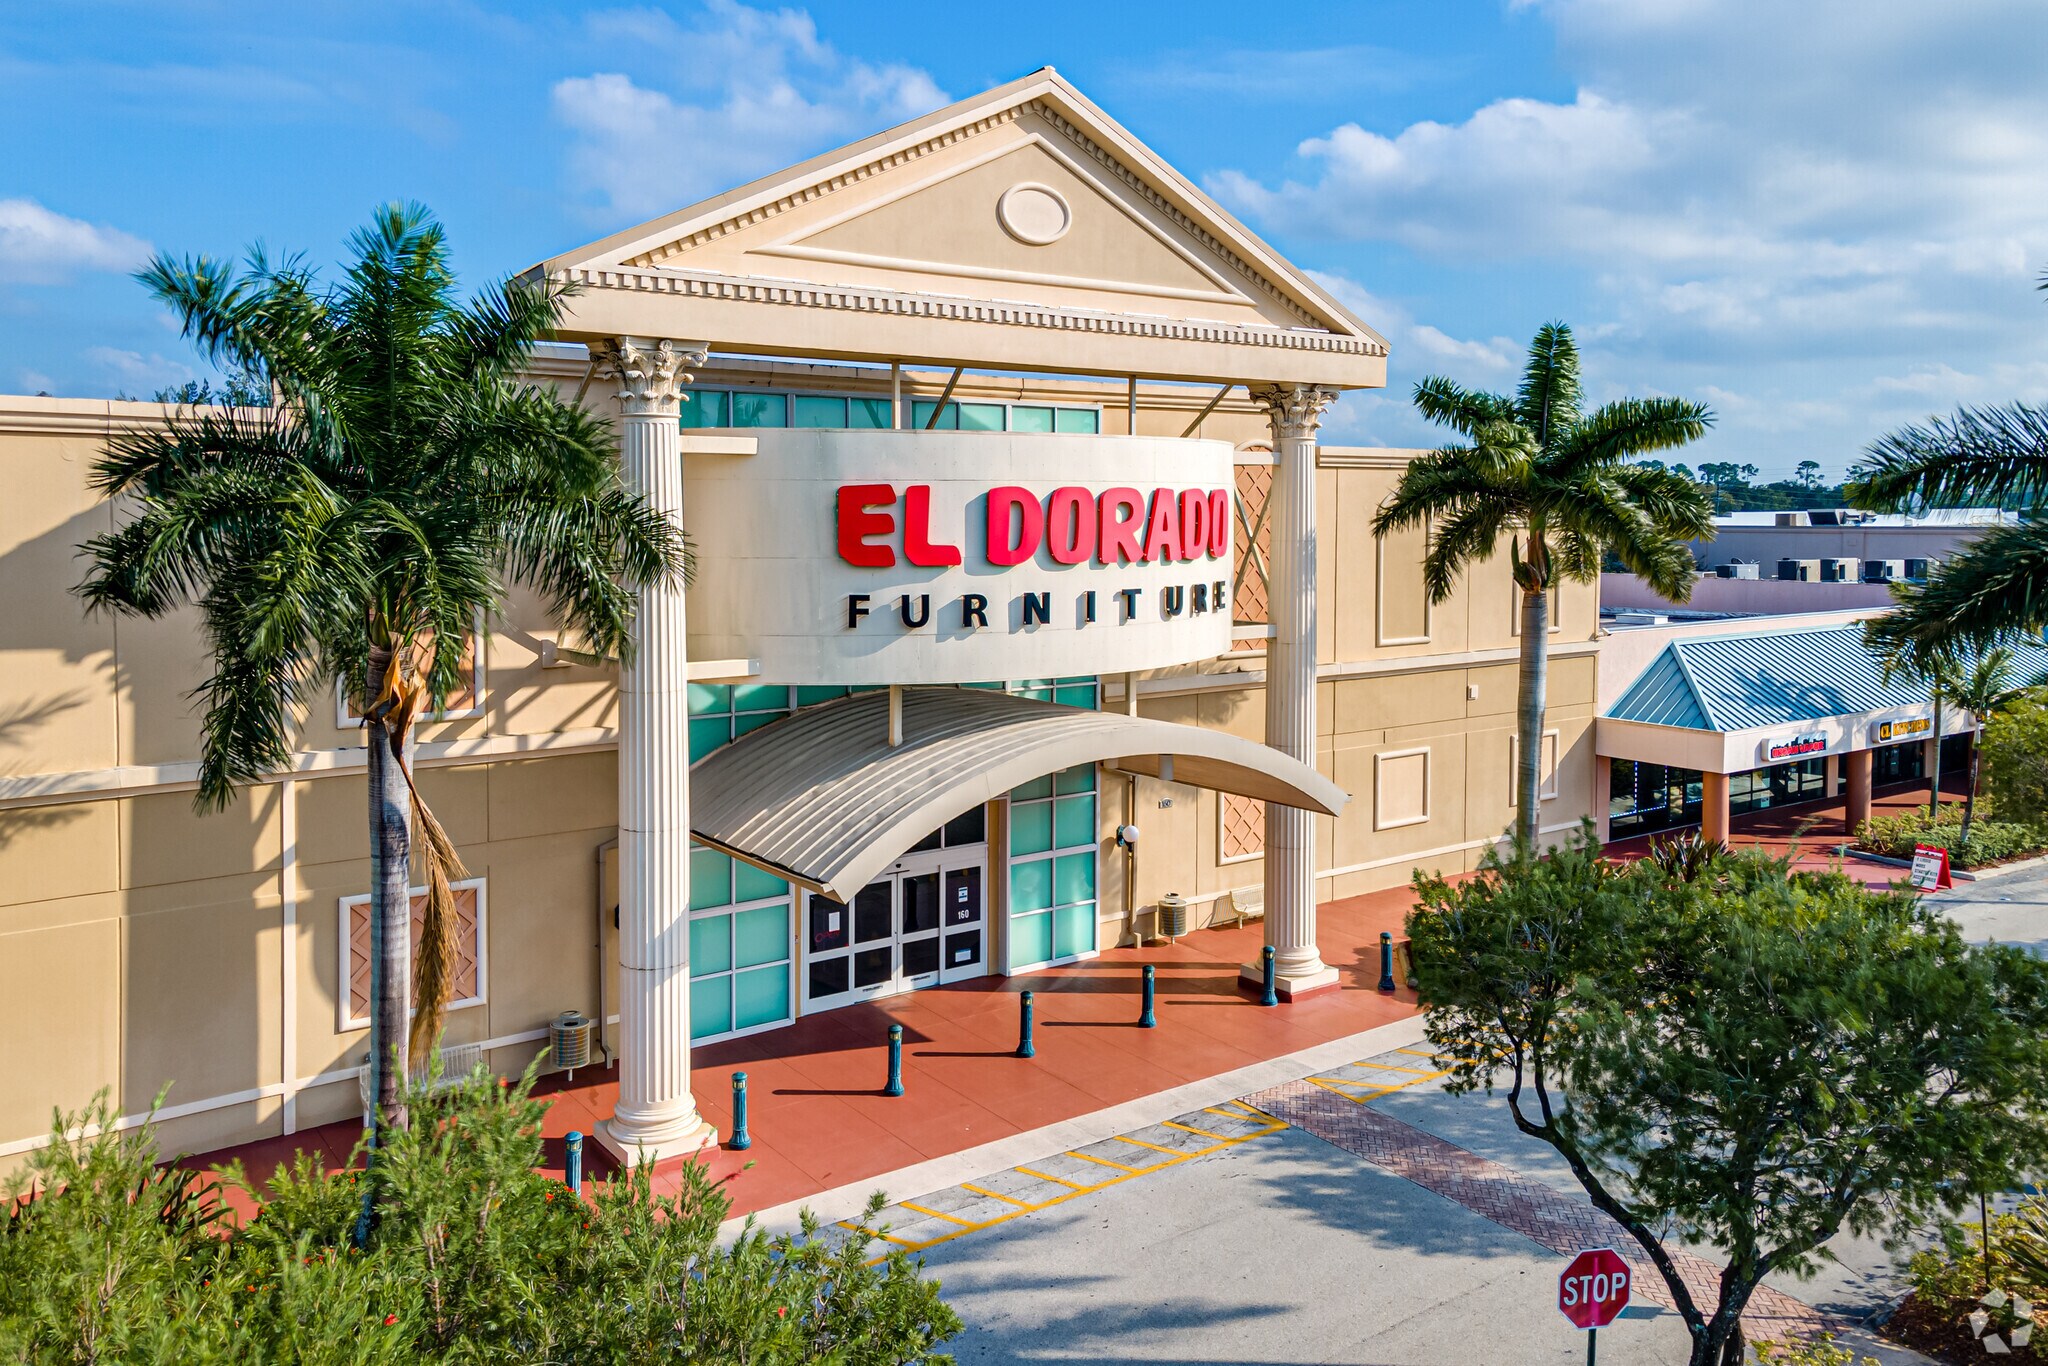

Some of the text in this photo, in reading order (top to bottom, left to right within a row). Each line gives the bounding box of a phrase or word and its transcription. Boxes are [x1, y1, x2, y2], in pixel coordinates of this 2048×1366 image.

[836, 483, 1229, 568] EL DORADO
[847, 580, 1227, 629] FURNITURE
[957, 909, 970, 920] 160
[1563, 1272, 1627, 1306] STOP
